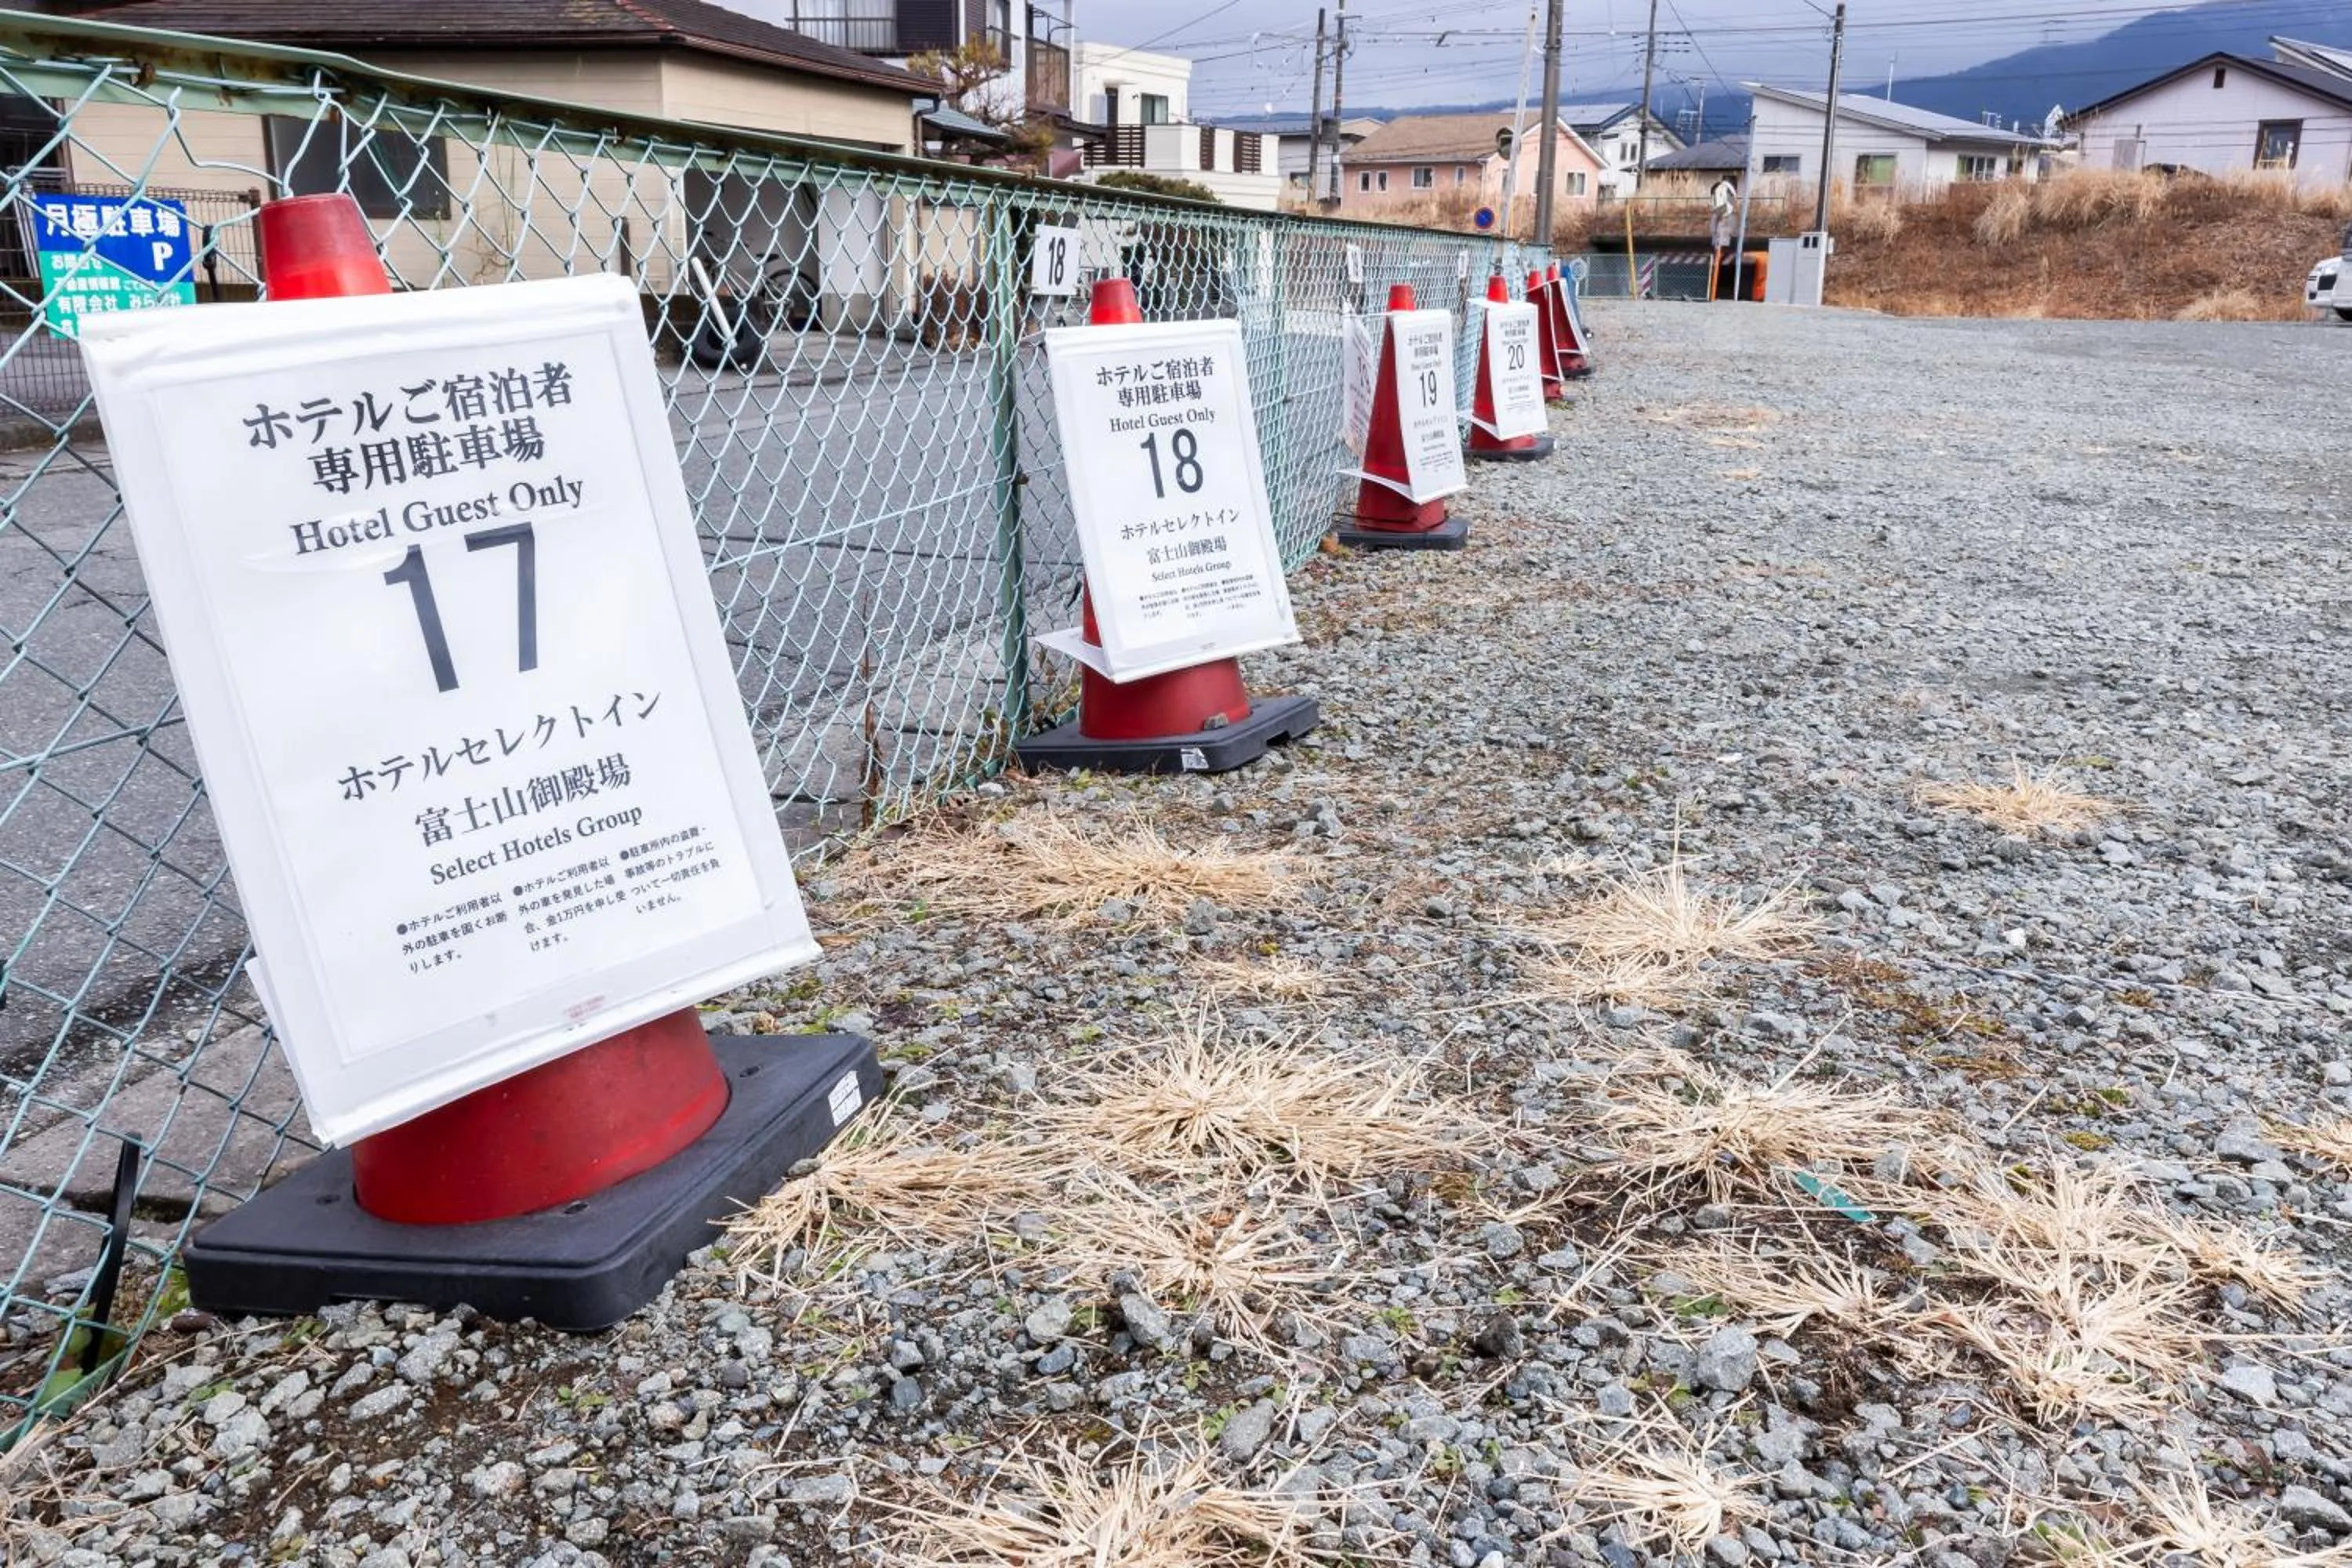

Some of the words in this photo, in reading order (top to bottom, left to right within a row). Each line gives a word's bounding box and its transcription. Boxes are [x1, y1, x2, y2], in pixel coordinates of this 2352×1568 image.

[45, 204, 180, 237] 月極駐車場
[152, 241, 173, 270] P
[1049, 237, 1065, 285] 18
[1096, 356, 1214, 387] ホテルご宿泊者
[1508, 344, 1524, 370] 20
[243, 362, 572, 449] ホテルご宿泊者
[1117, 380, 1202, 408] 専用駐車場
[1419, 370, 1437, 408] 19
[1110, 413, 1145, 432] Hotel
[1148, 410, 1184, 428] Guest
[1187, 408, 1216, 425] Only
[307, 416, 545, 494] 専用駐車場
[1140, 428, 1203, 499] 18
[289, 508, 394, 554] Hotel
[402, 491, 499, 532] Guest
[510, 474, 583, 512] Only
[1121, 508, 1240, 540] ホテルセレクトイン
[1146, 535, 1228, 565] 富士山御殿場
[1152, 571, 1177, 583] Select
[383, 522, 538, 693] 17
[338, 691, 661, 800] ホテルセレクトイン
[415, 752, 631, 847] 富士山御殿場
[430, 850, 498, 885] Select
[501, 826, 572, 863] Hotels
[577, 806, 643, 838] Group
